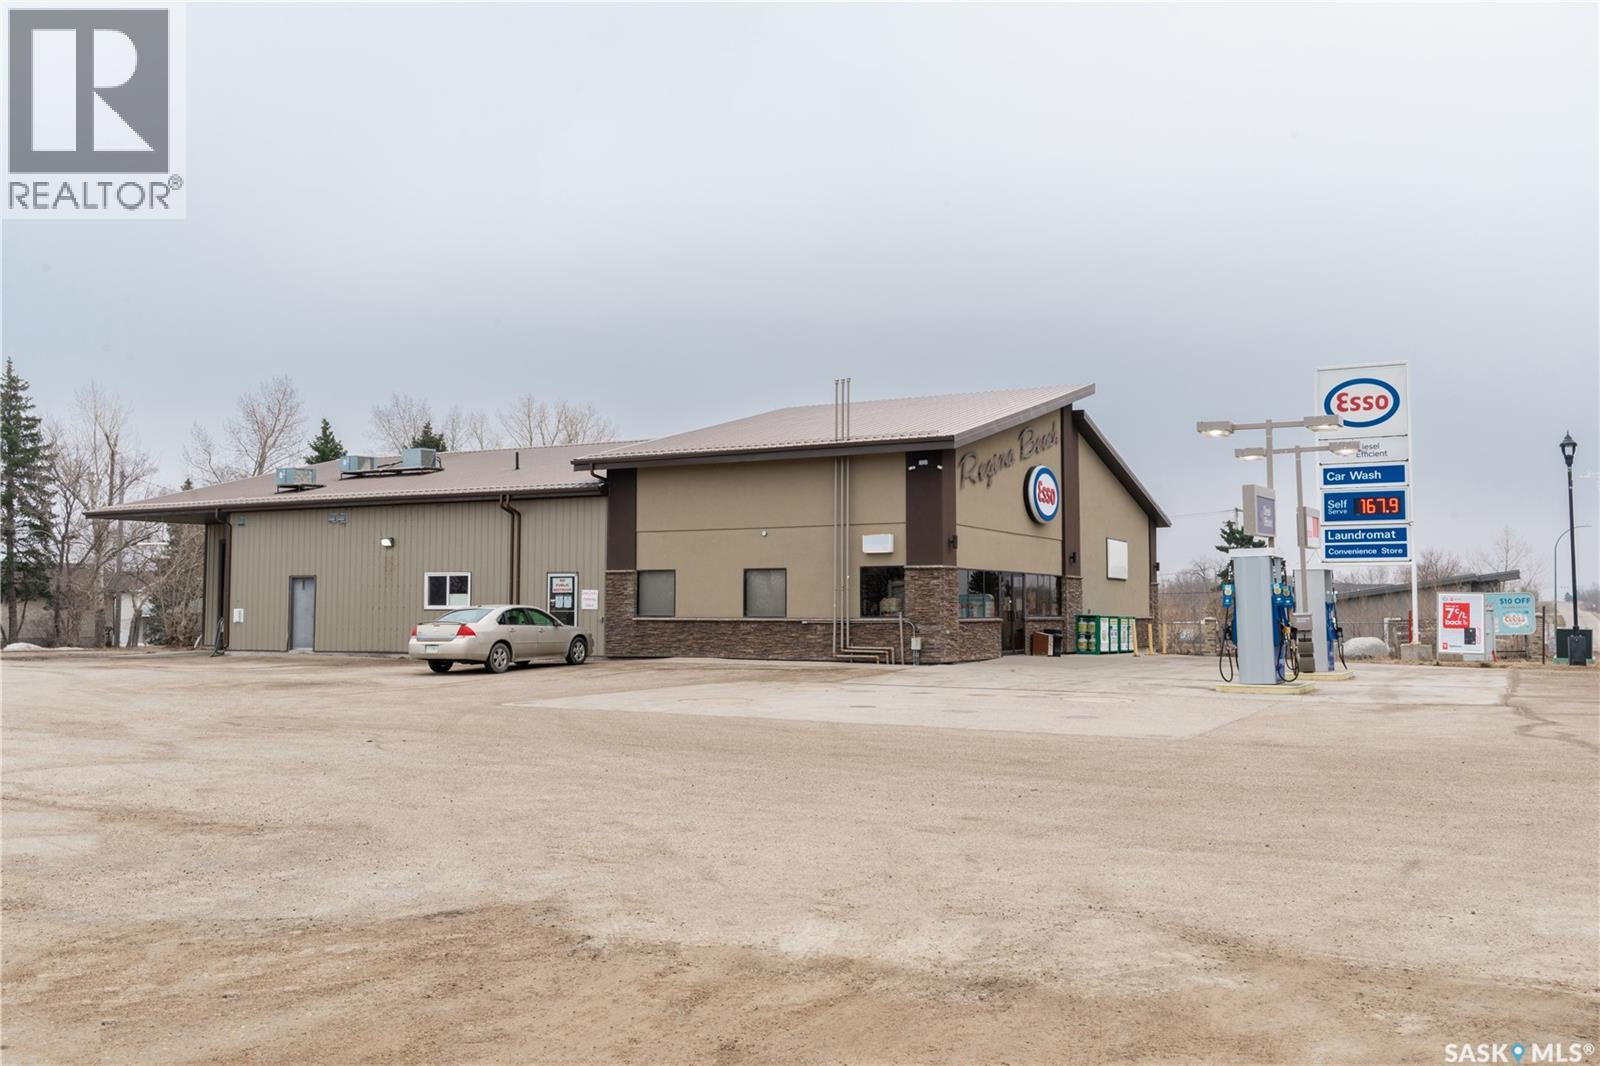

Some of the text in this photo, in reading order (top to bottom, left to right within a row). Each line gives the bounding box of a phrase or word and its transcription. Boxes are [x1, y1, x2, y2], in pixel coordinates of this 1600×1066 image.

[1336, 392, 1389, 412] Esso
[958, 421, 1059, 491] Regina Beach
[1326, 470, 1382, 481] Car Wash
[1037, 480, 1056, 506] Esso
[1327, 500, 1347, 510] Self
[1359, 497, 1399, 514] 167.9
[1327, 529, 1396, 541] Laundromat
[1328, 547, 1403, 556] Convenience Store
[1514, 597, 1530, 605] OFF
